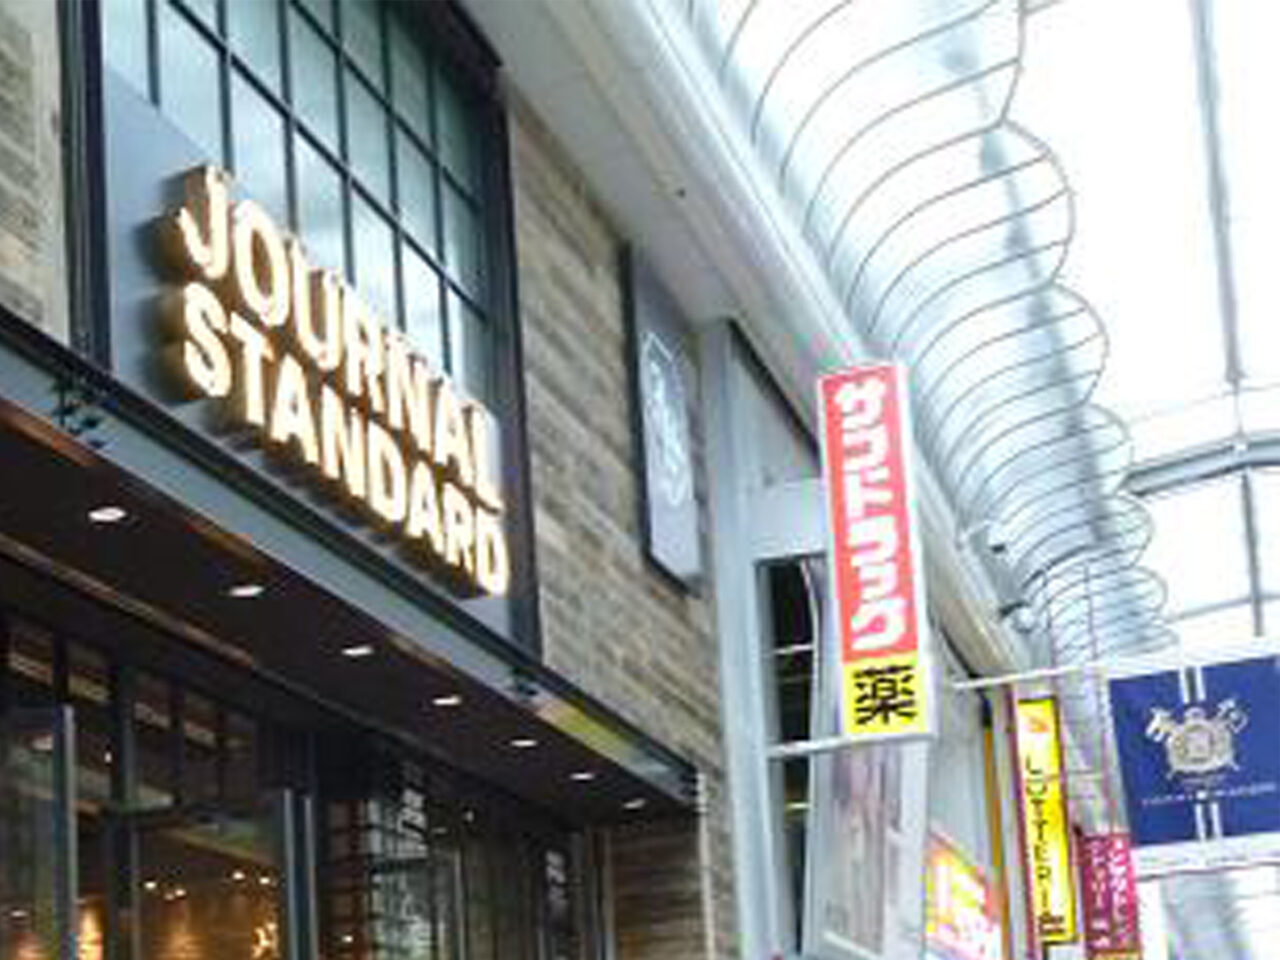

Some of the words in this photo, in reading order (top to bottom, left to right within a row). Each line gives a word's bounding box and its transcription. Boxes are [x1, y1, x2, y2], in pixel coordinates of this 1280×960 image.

[179, 165, 505, 514] JOURNAL
[183, 282, 510, 596] STANDARD
[852, 664, 918, 726] 薬
